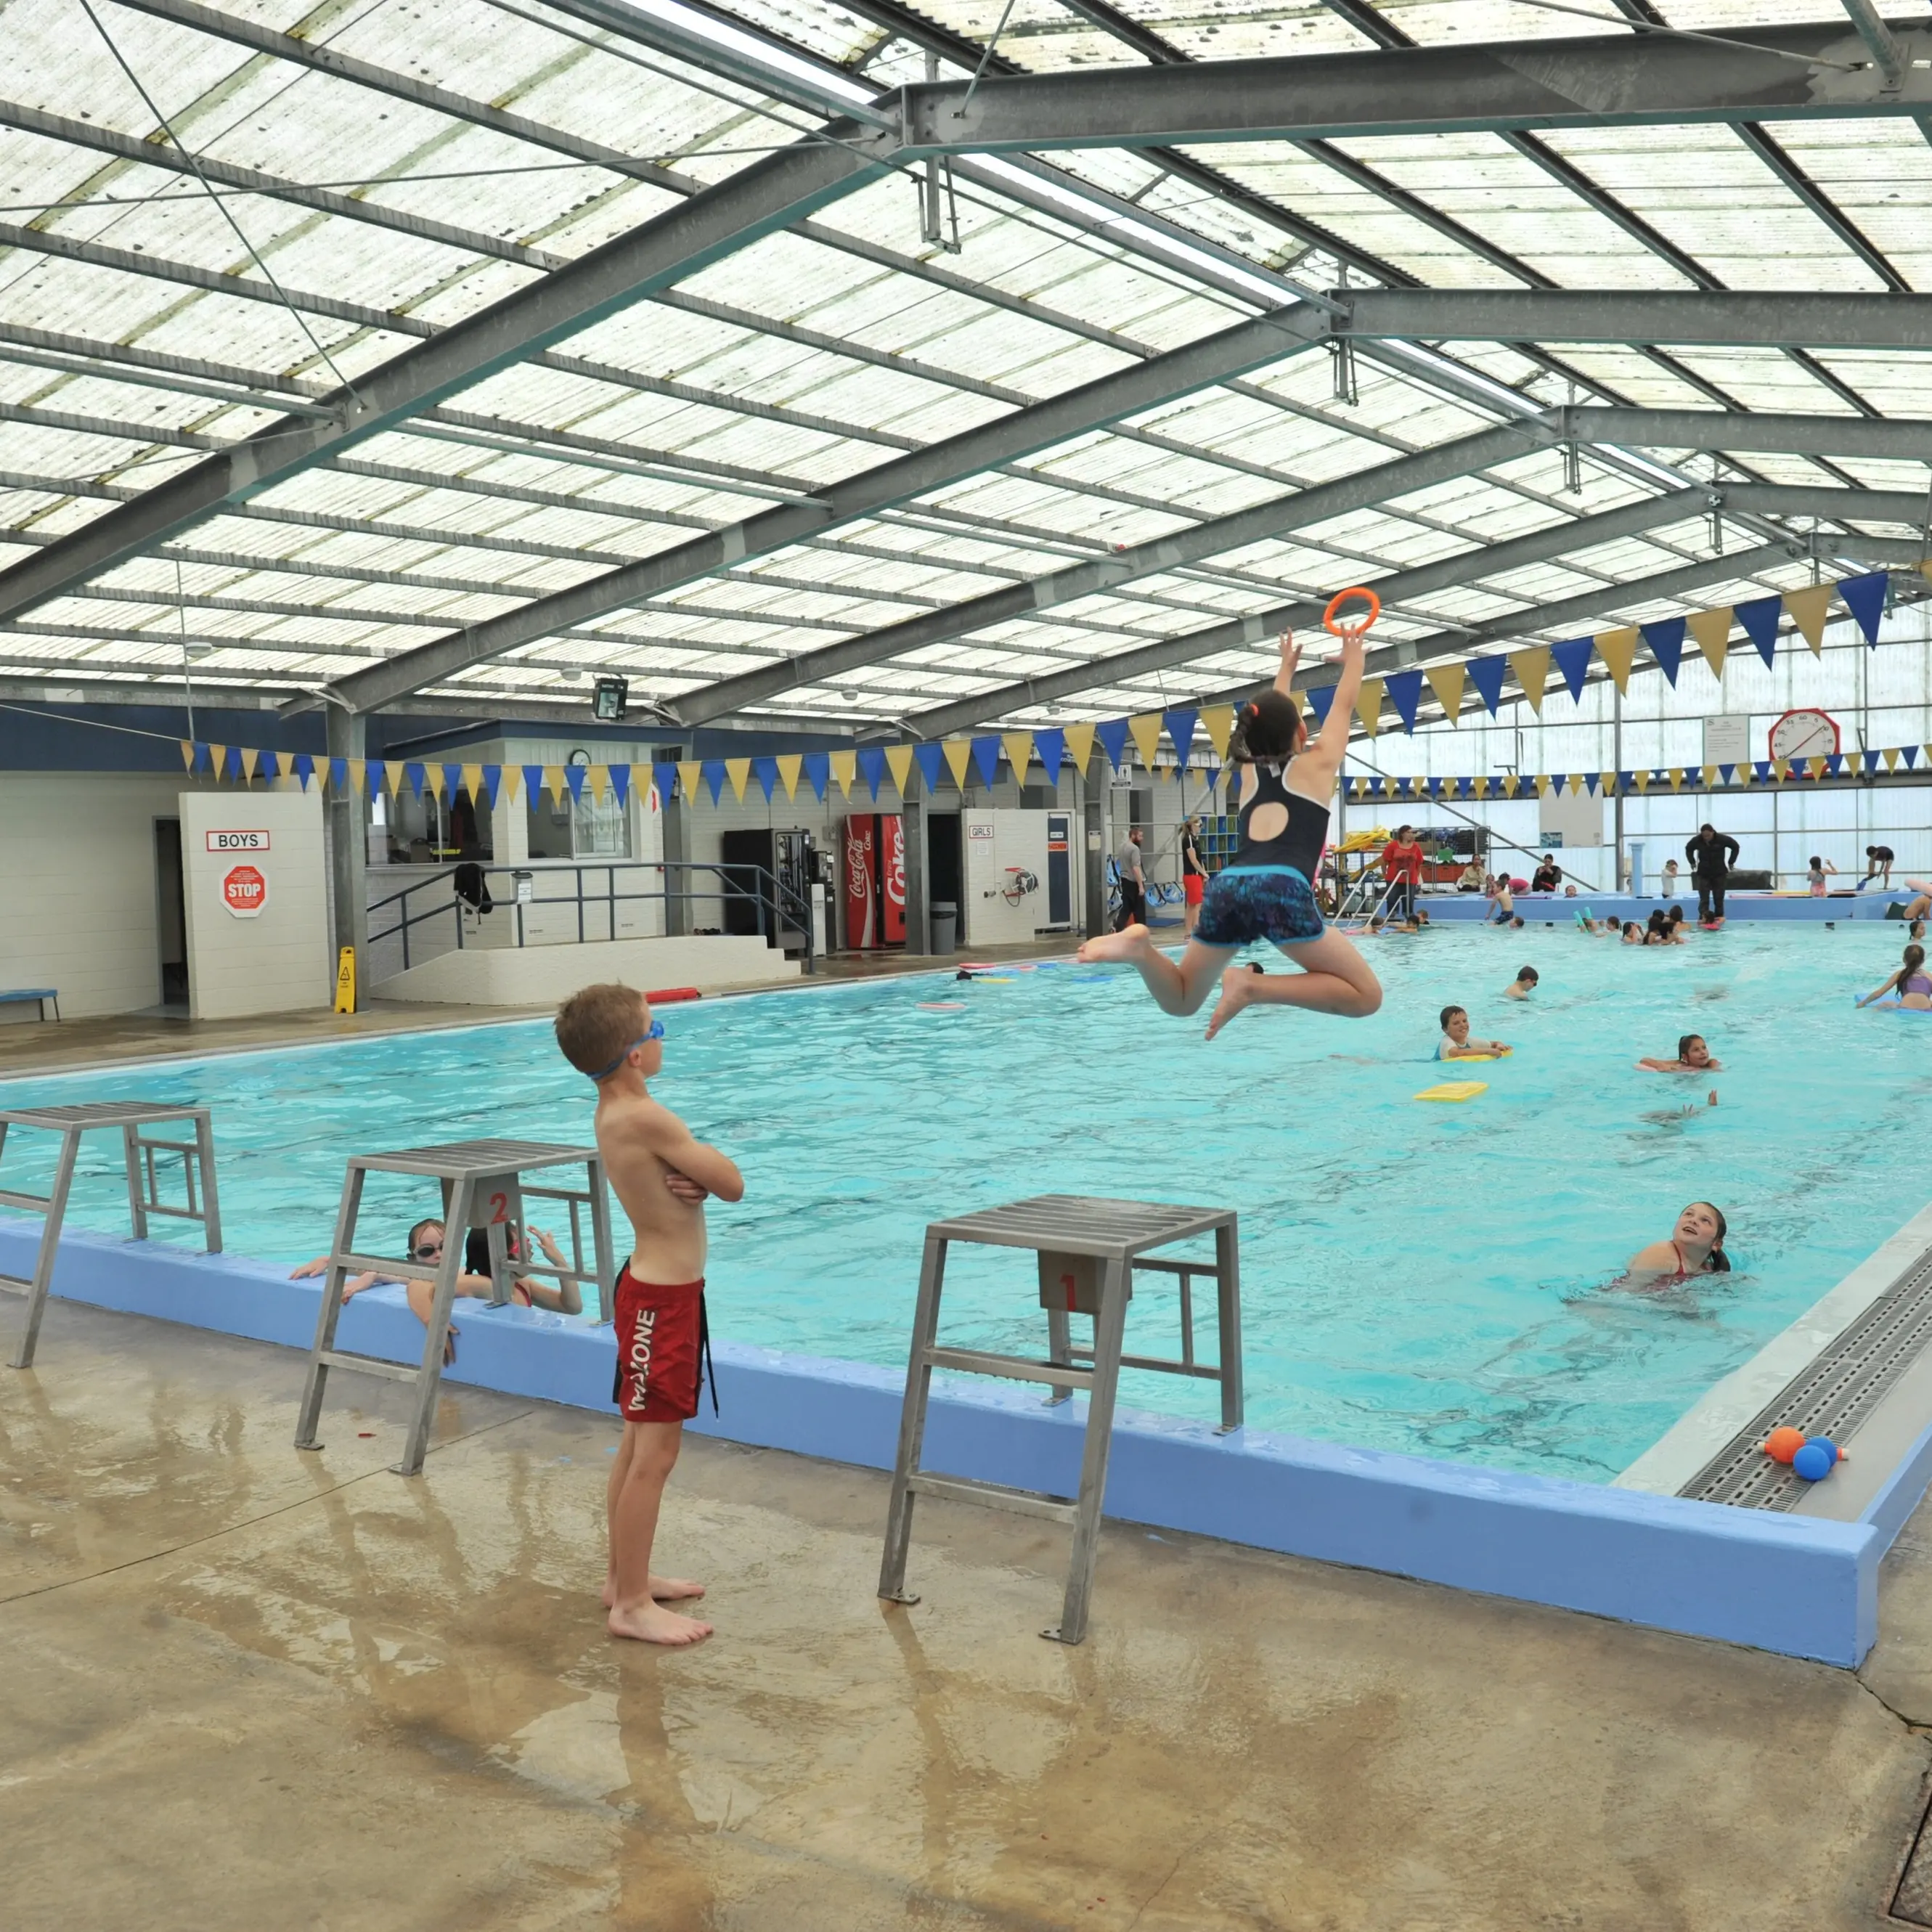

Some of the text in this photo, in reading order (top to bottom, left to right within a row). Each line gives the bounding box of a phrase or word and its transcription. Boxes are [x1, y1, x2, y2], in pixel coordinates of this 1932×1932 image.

[972, 827, 991, 836] GIRLS
[219, 833, 258, 848] BOYS
[227, 883, 261, 898] STOP
[489, 1191, 509, 1225] 2
[1059, 1274, 1077, 1312] 1
